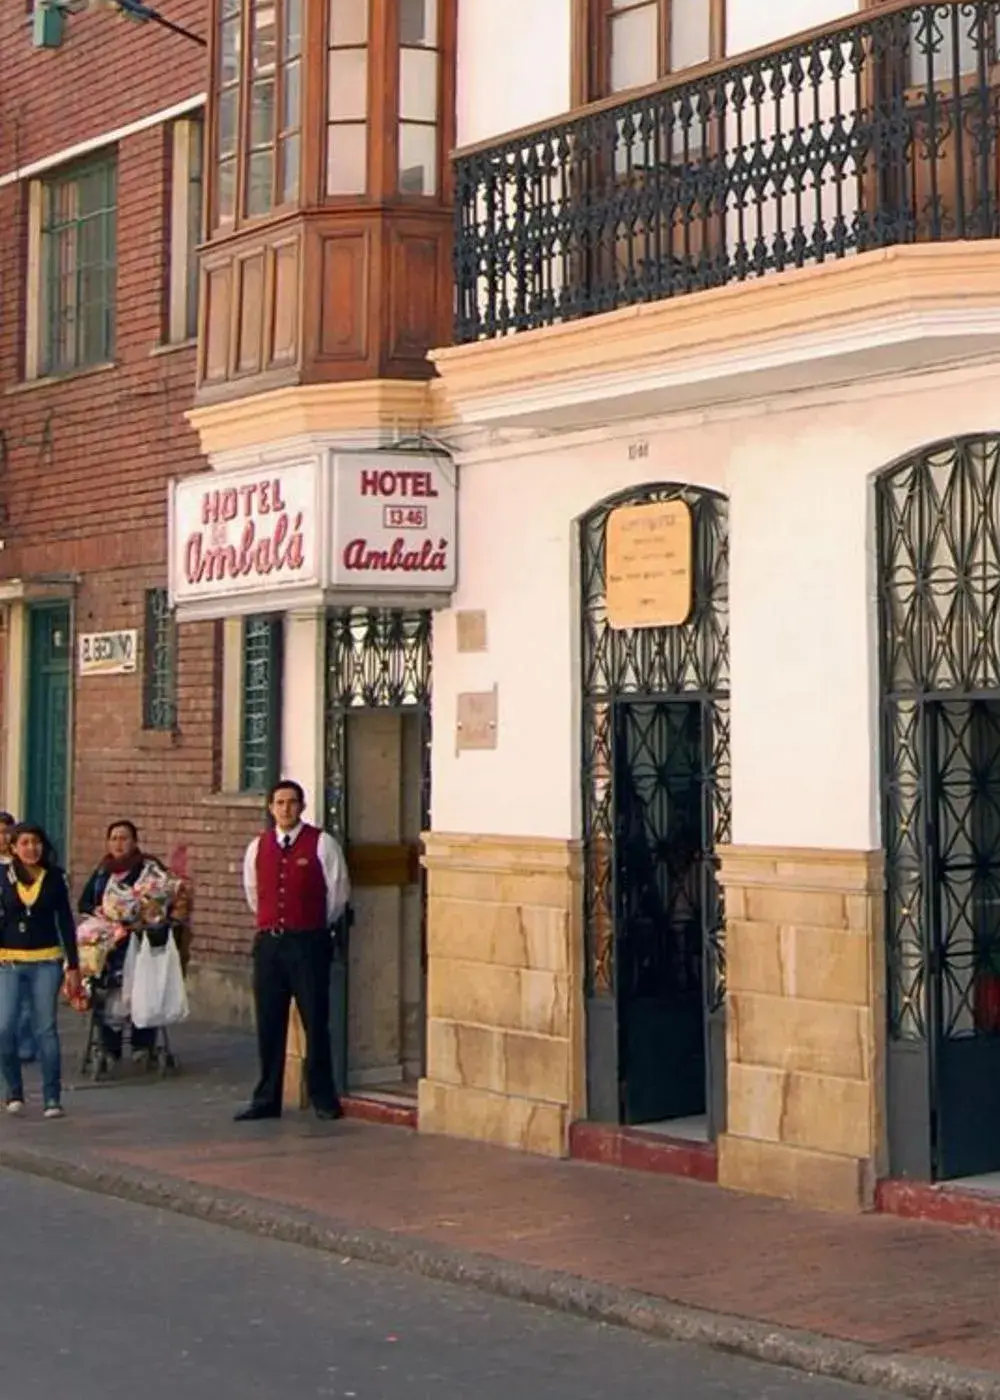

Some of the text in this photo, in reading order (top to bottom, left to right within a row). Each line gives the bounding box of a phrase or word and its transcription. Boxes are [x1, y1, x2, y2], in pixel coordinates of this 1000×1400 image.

[201, 478, 286, 524] HOTEL
[361, 470, 438, 498] HOTEL
[184, 511, 306, 584] Ambalá
[343, 537, 449, 573] Ambalá
